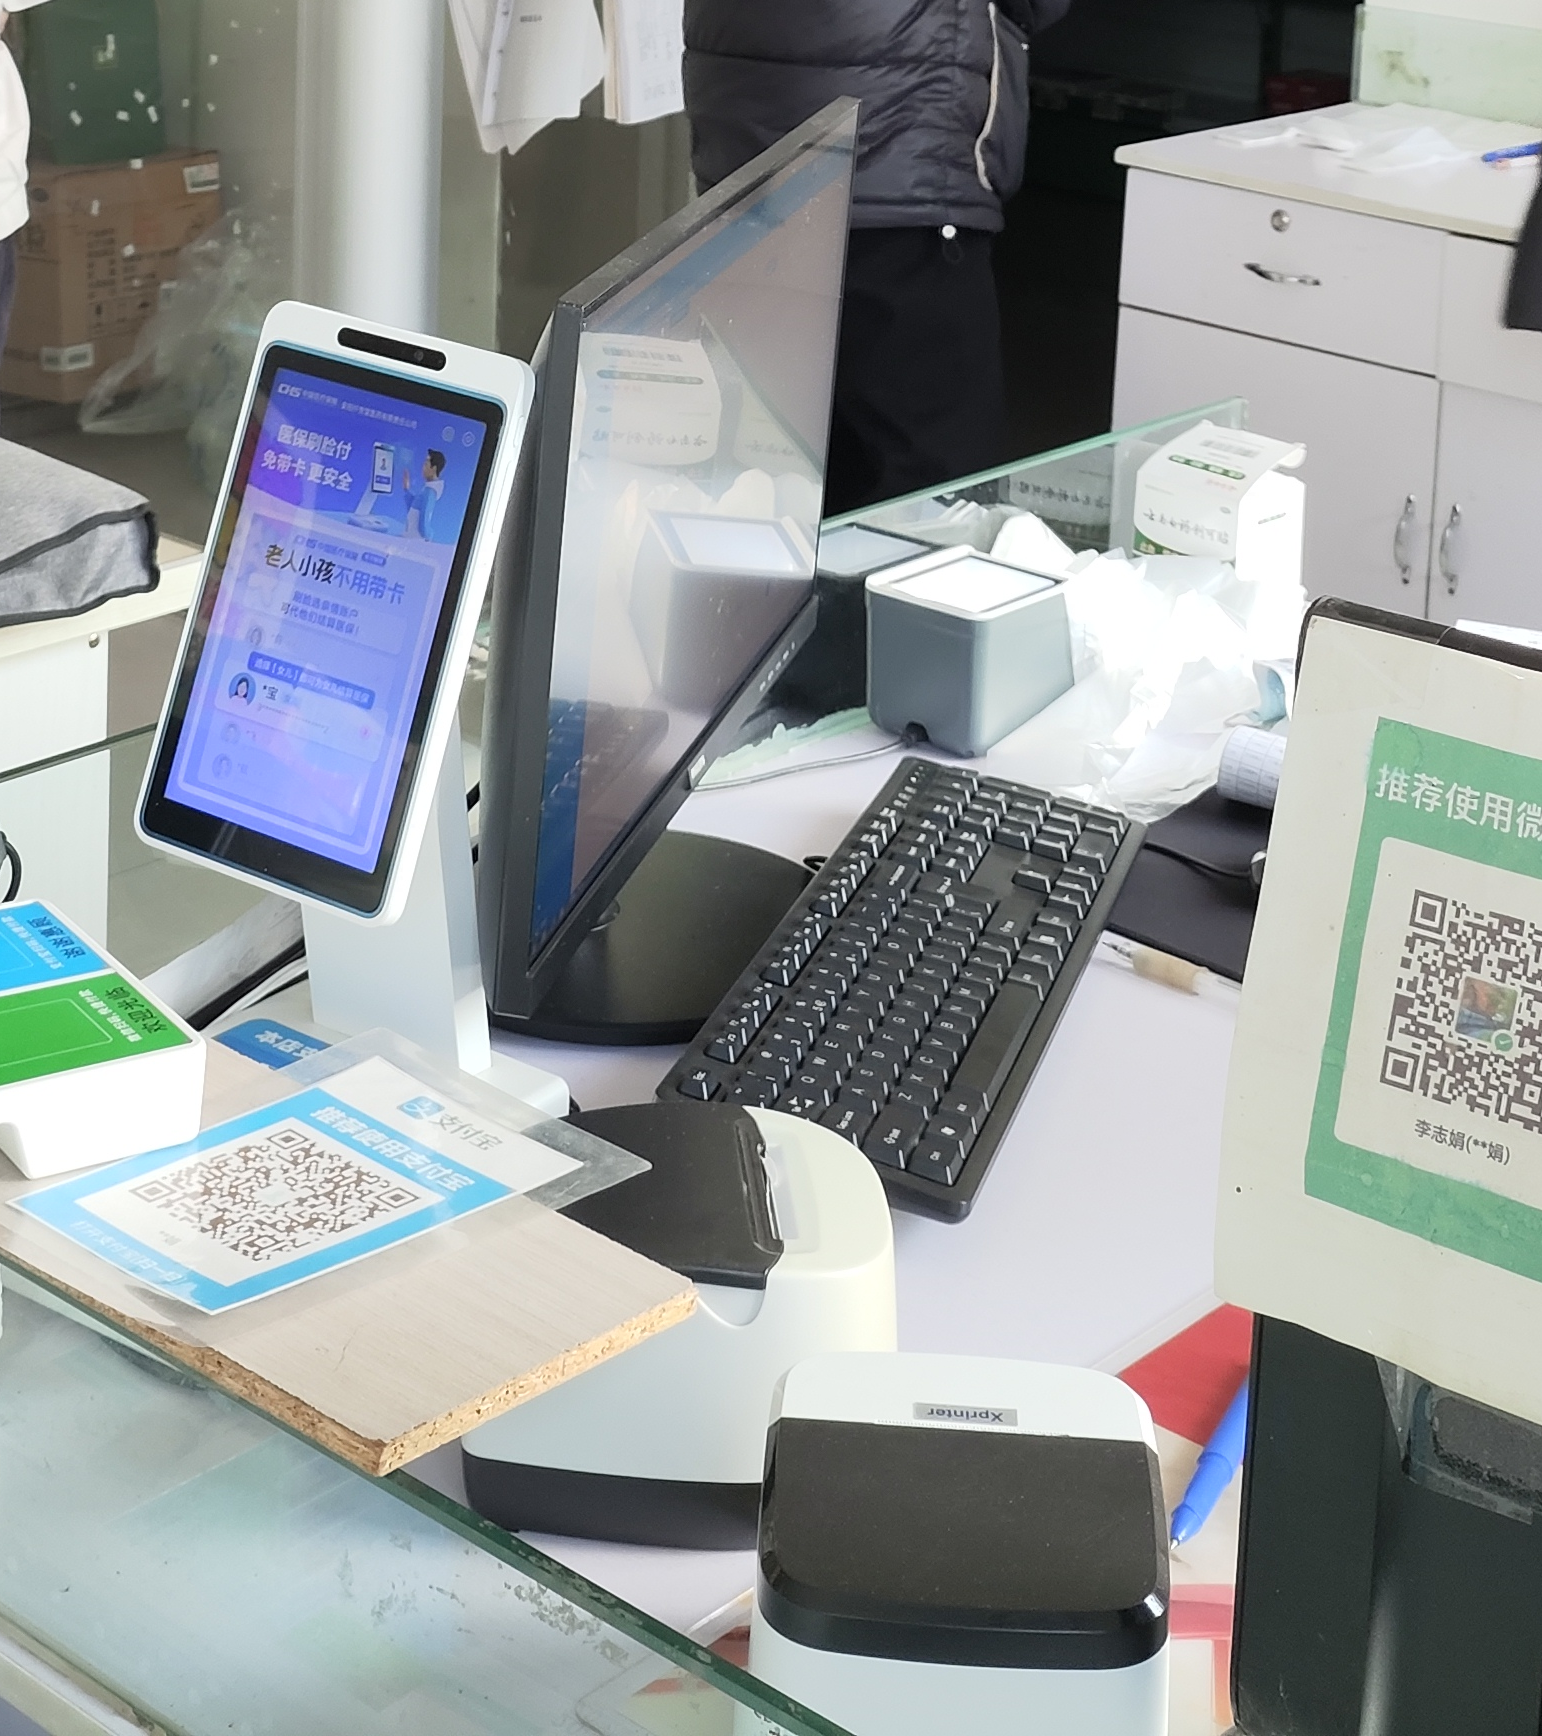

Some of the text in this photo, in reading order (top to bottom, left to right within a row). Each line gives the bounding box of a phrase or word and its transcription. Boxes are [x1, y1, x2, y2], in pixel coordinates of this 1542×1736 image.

[277, 424, 354, 461] 医保刷脸付
[260, 449, 355, 492] 免带卡 更安全
[264, 543, 407, 607] 老人小孩不用带卡
[99, 984, 171, 1036] 欢迎光临
[304, 1104, 479, 1192] 推荐使用支付宝
[427, 1112, 508, 1151] 支付宝
[926, 1405, 1005, 1424] Xprinter
